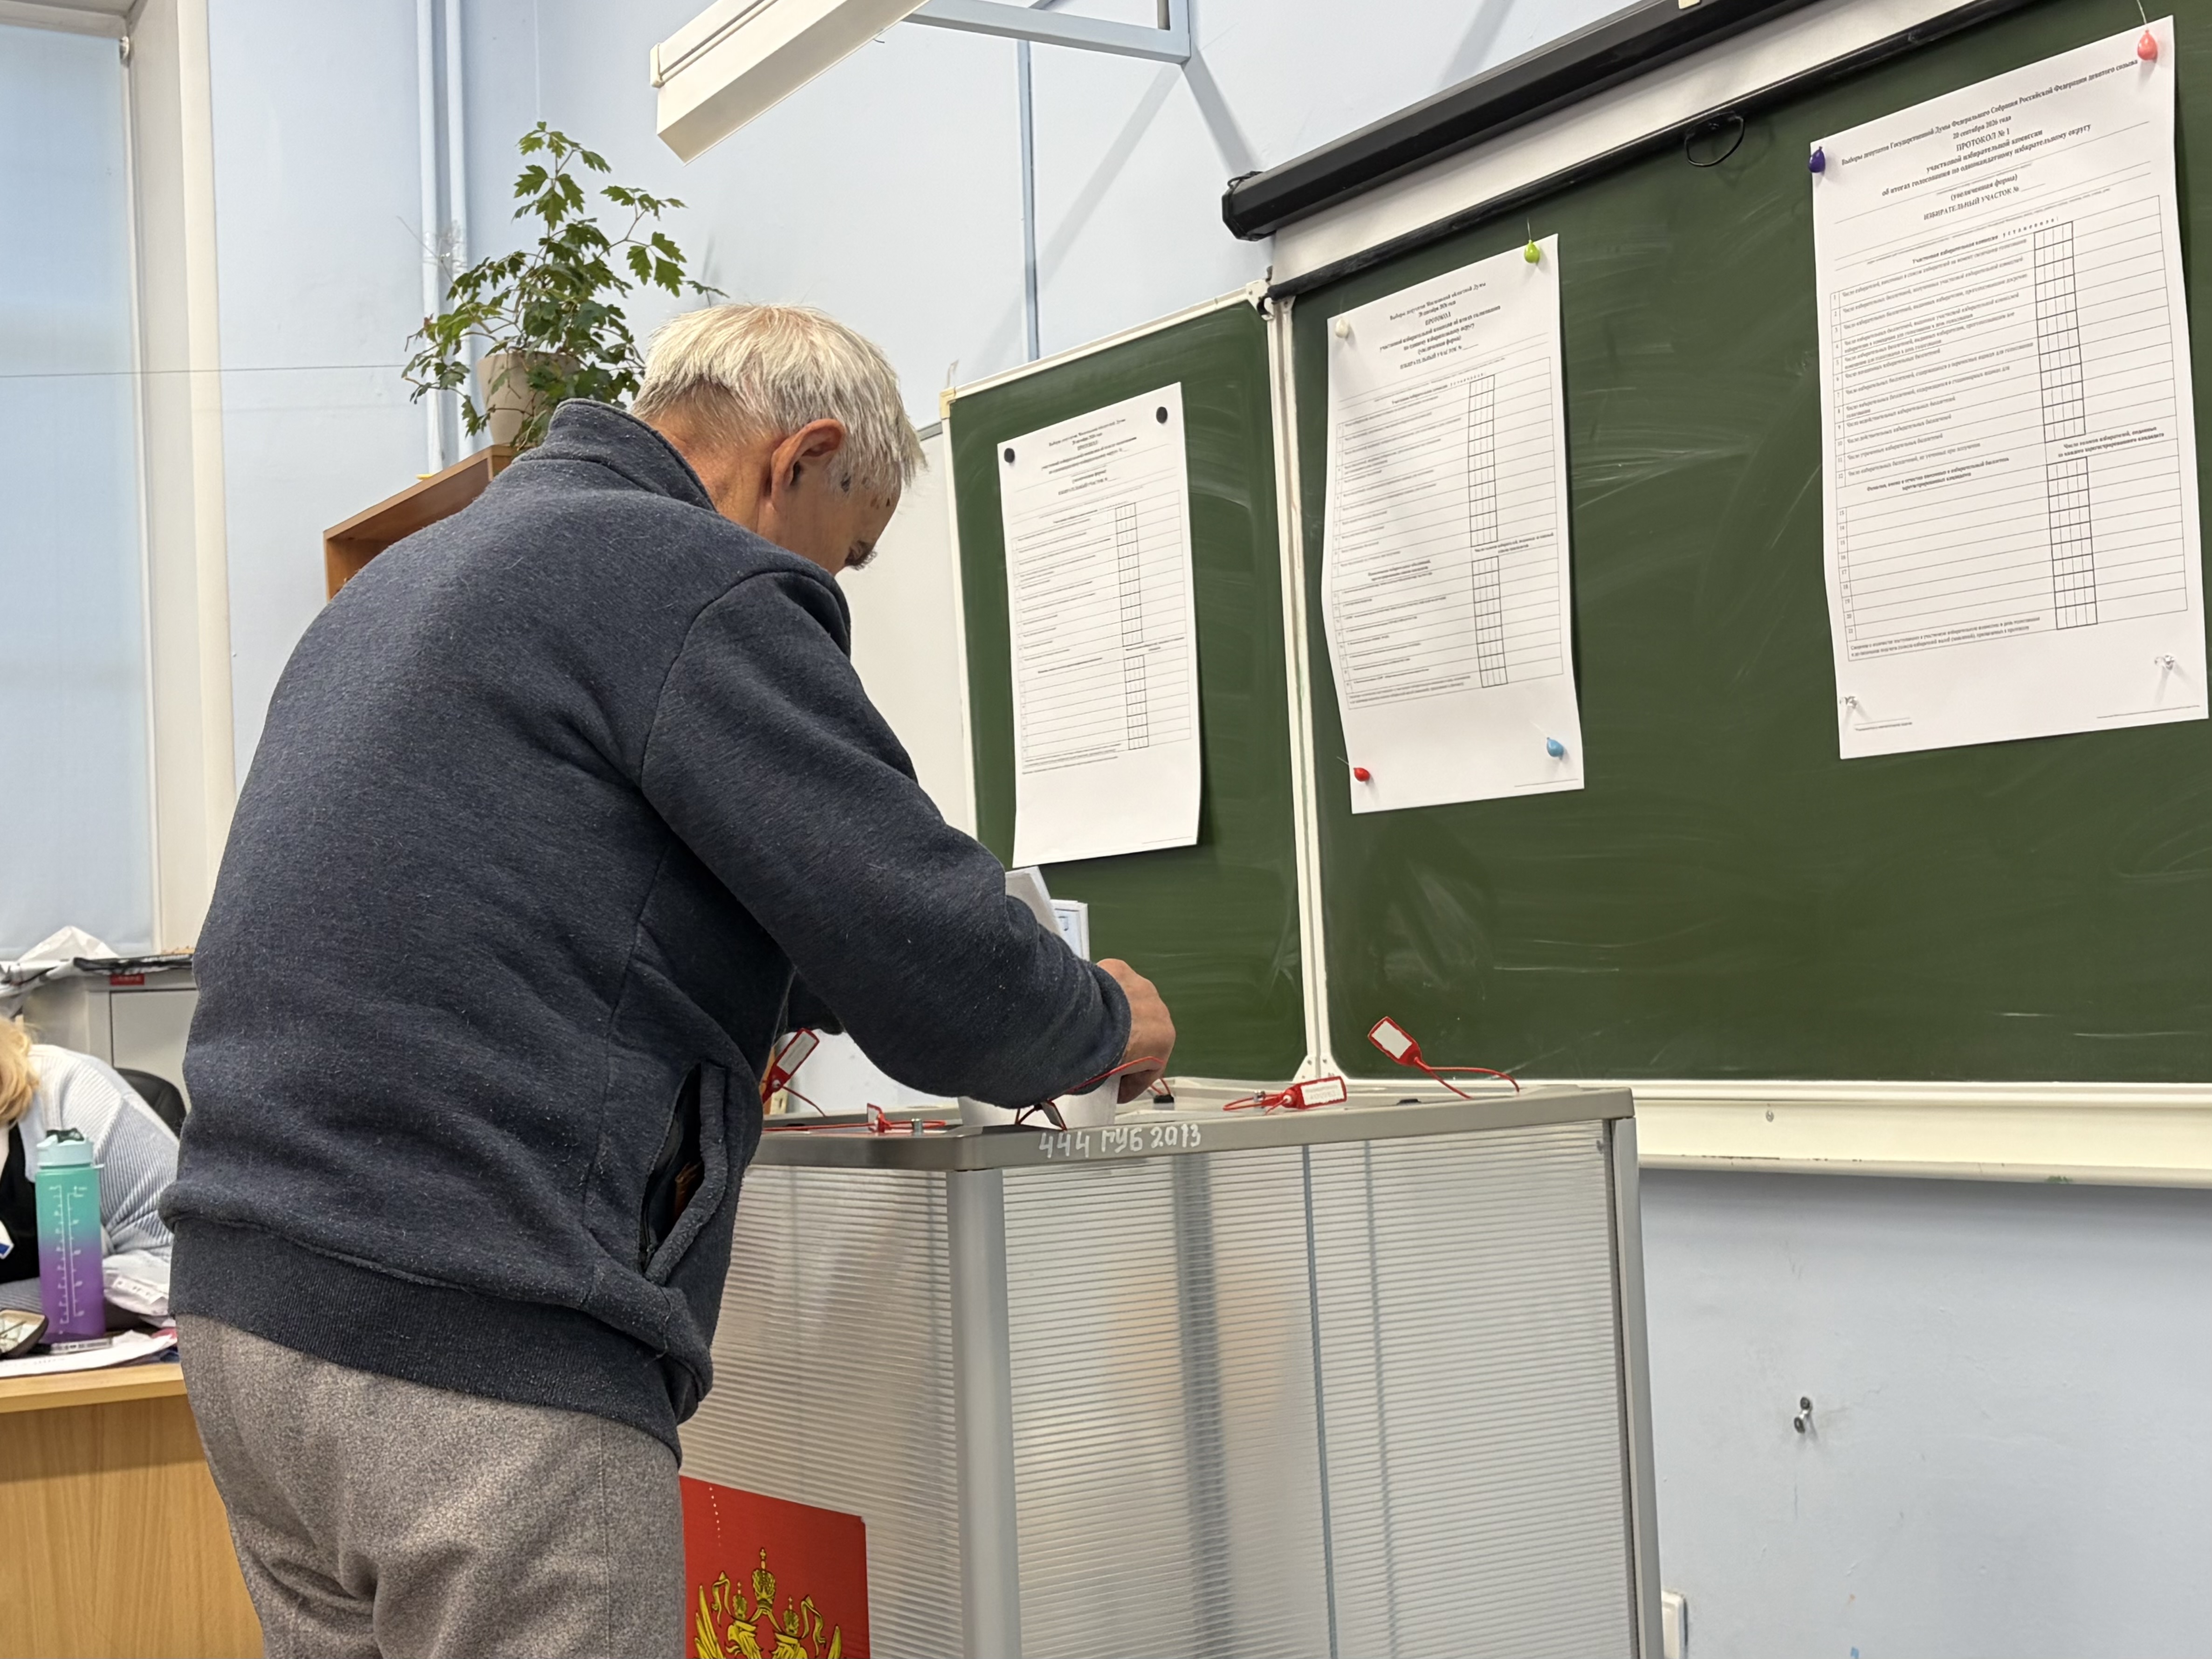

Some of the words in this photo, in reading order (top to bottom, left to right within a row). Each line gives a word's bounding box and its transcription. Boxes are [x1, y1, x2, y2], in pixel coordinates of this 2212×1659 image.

[1956, 131, 1996, 151] ПРОТОКОЛ
[1039, 1131, 1090, 1158] 444
[1150, 1123, 1201, 1149] 2013
